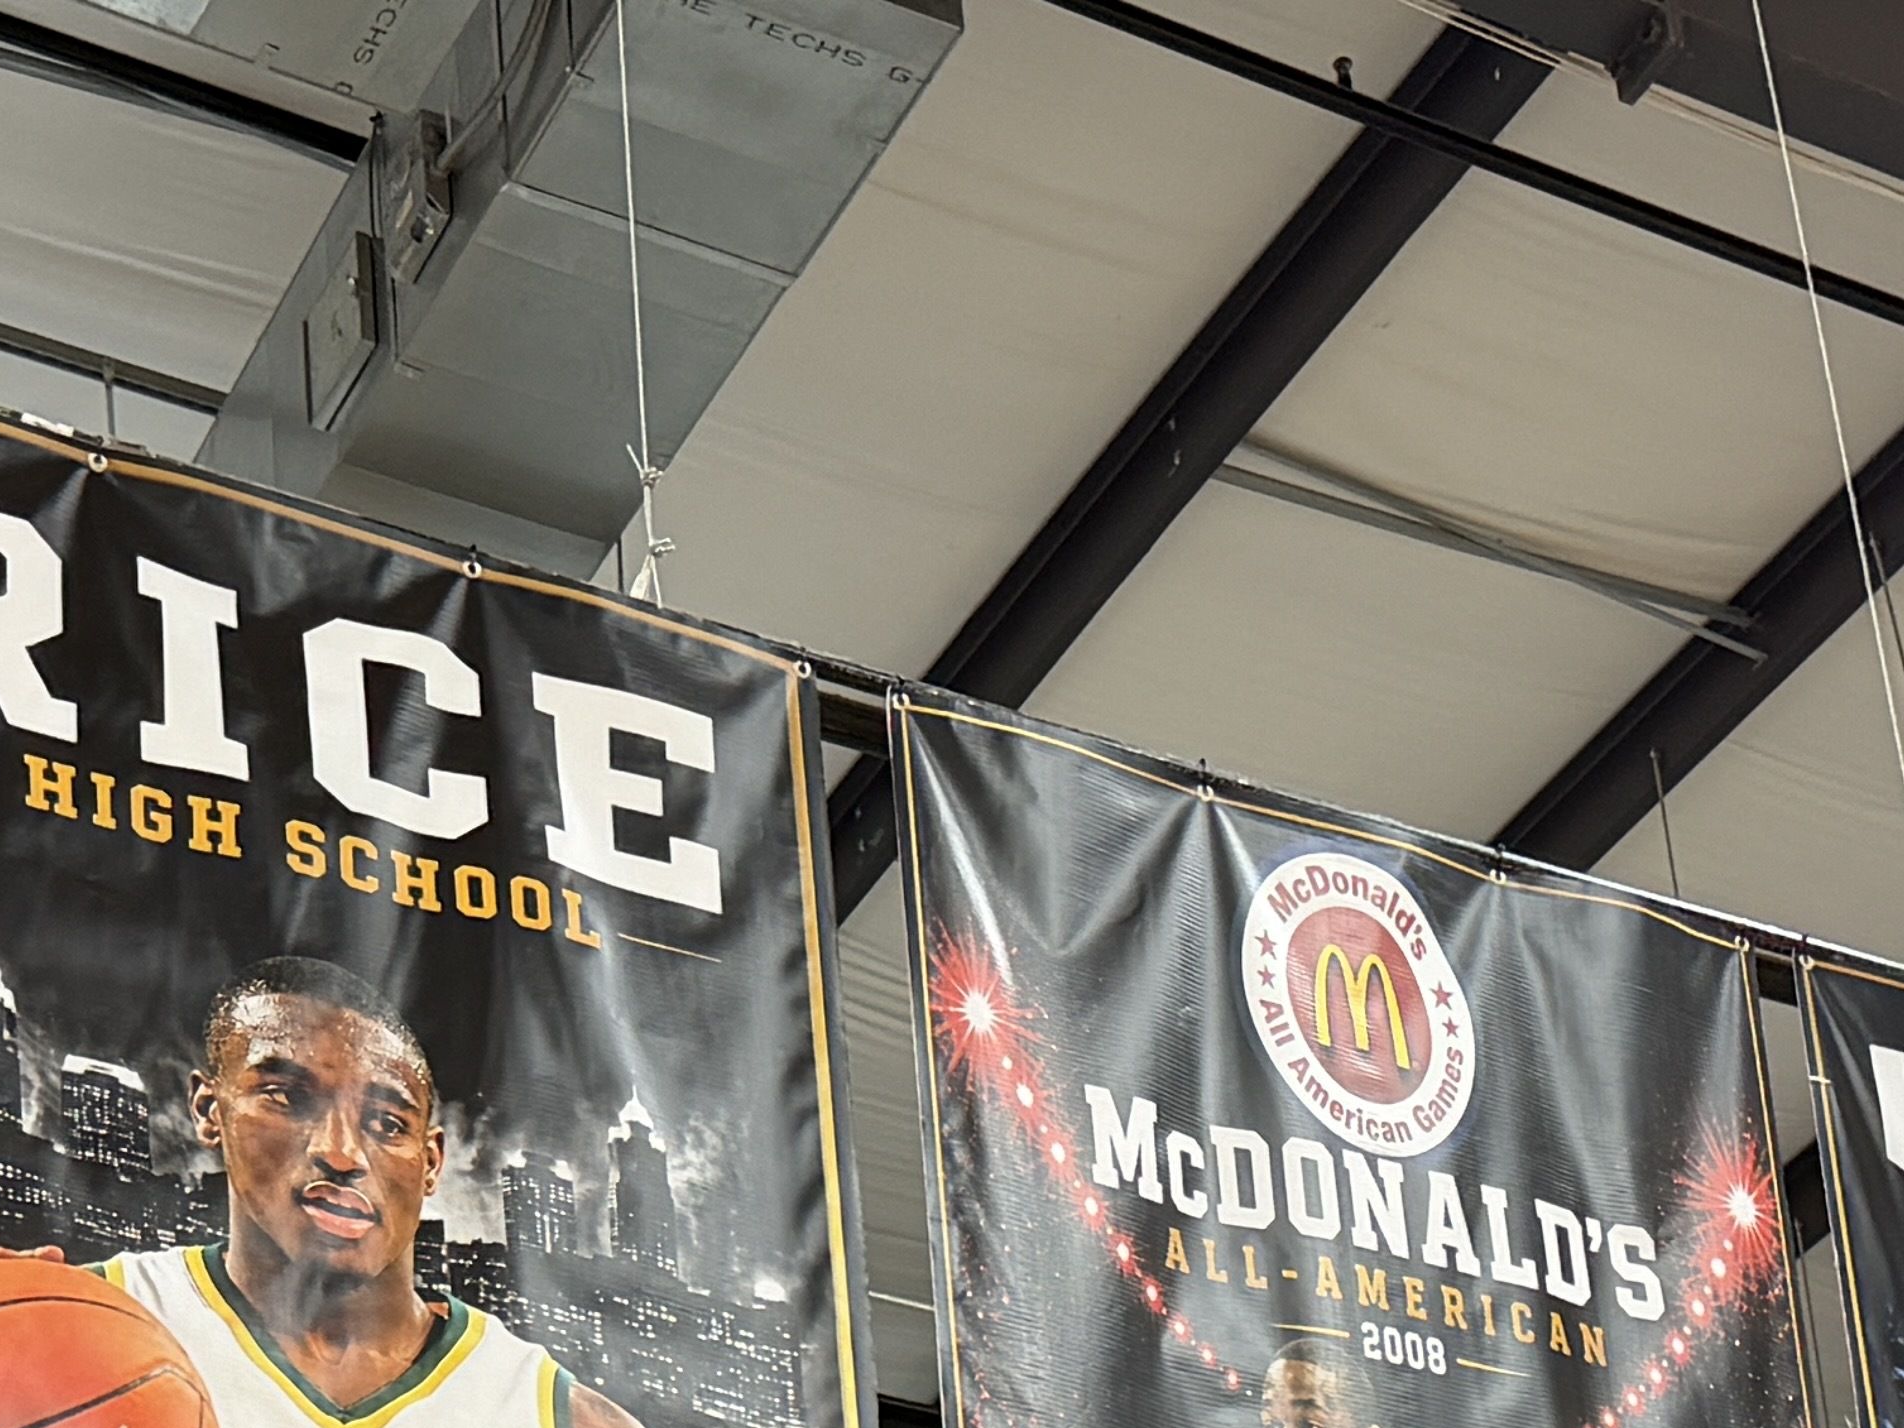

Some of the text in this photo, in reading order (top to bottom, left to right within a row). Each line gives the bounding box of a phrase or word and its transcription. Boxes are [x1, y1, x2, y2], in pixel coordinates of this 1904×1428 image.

[746, 13, 868, 68] TECHS
[23, 753, 604, 950] HIGH SCHOOL
[1267, 865, 1427, 961] McDonald's
[1259, 997, 1464, 1144] All American Games
[1165, 1225, 1610, 1368] ALL-AMERICAN
[1360, 1320, 1448, 1378] 2008
